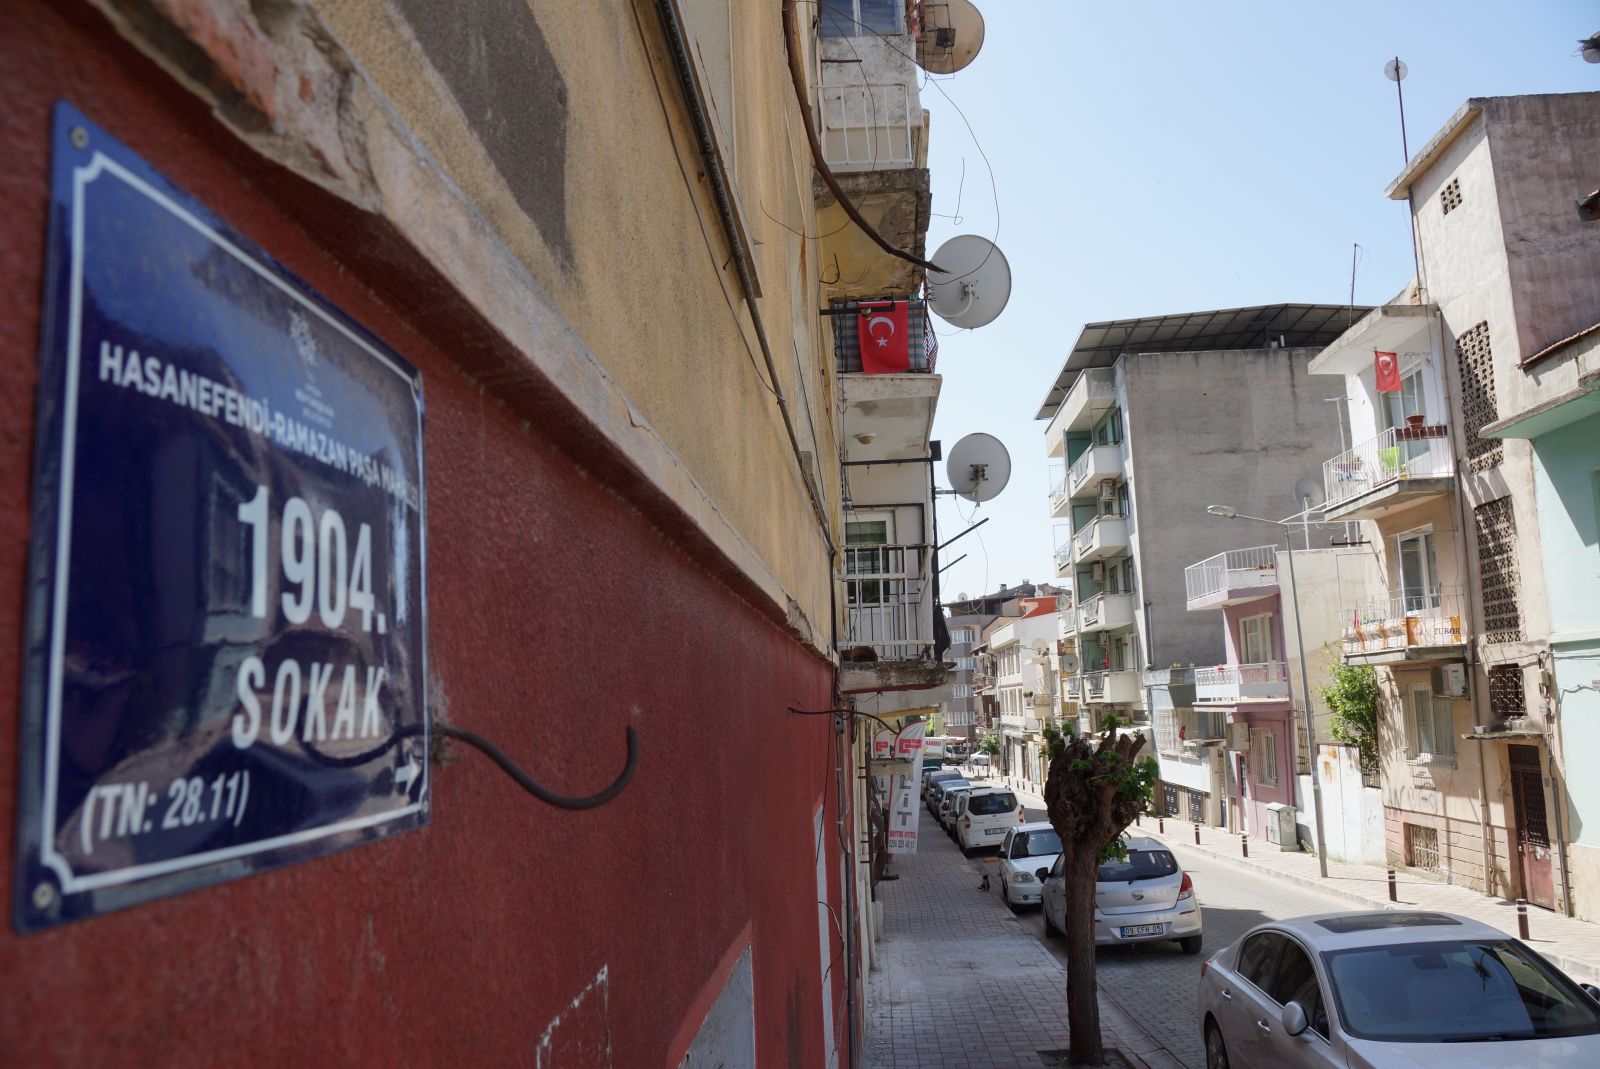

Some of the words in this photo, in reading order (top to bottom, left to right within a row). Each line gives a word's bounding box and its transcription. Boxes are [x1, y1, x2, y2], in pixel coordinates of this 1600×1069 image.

[98, 339, 347, 473] HASANEFENDİ-RAMAZAN
[347, 446, 381, 489] PAŞA
[237, 484, 387, 635] 1904.
[231, 655, 385, 750] SOKAK
[79, 780, 158, 856] (TN:
[161, 767, 250, 831] 28.11)
